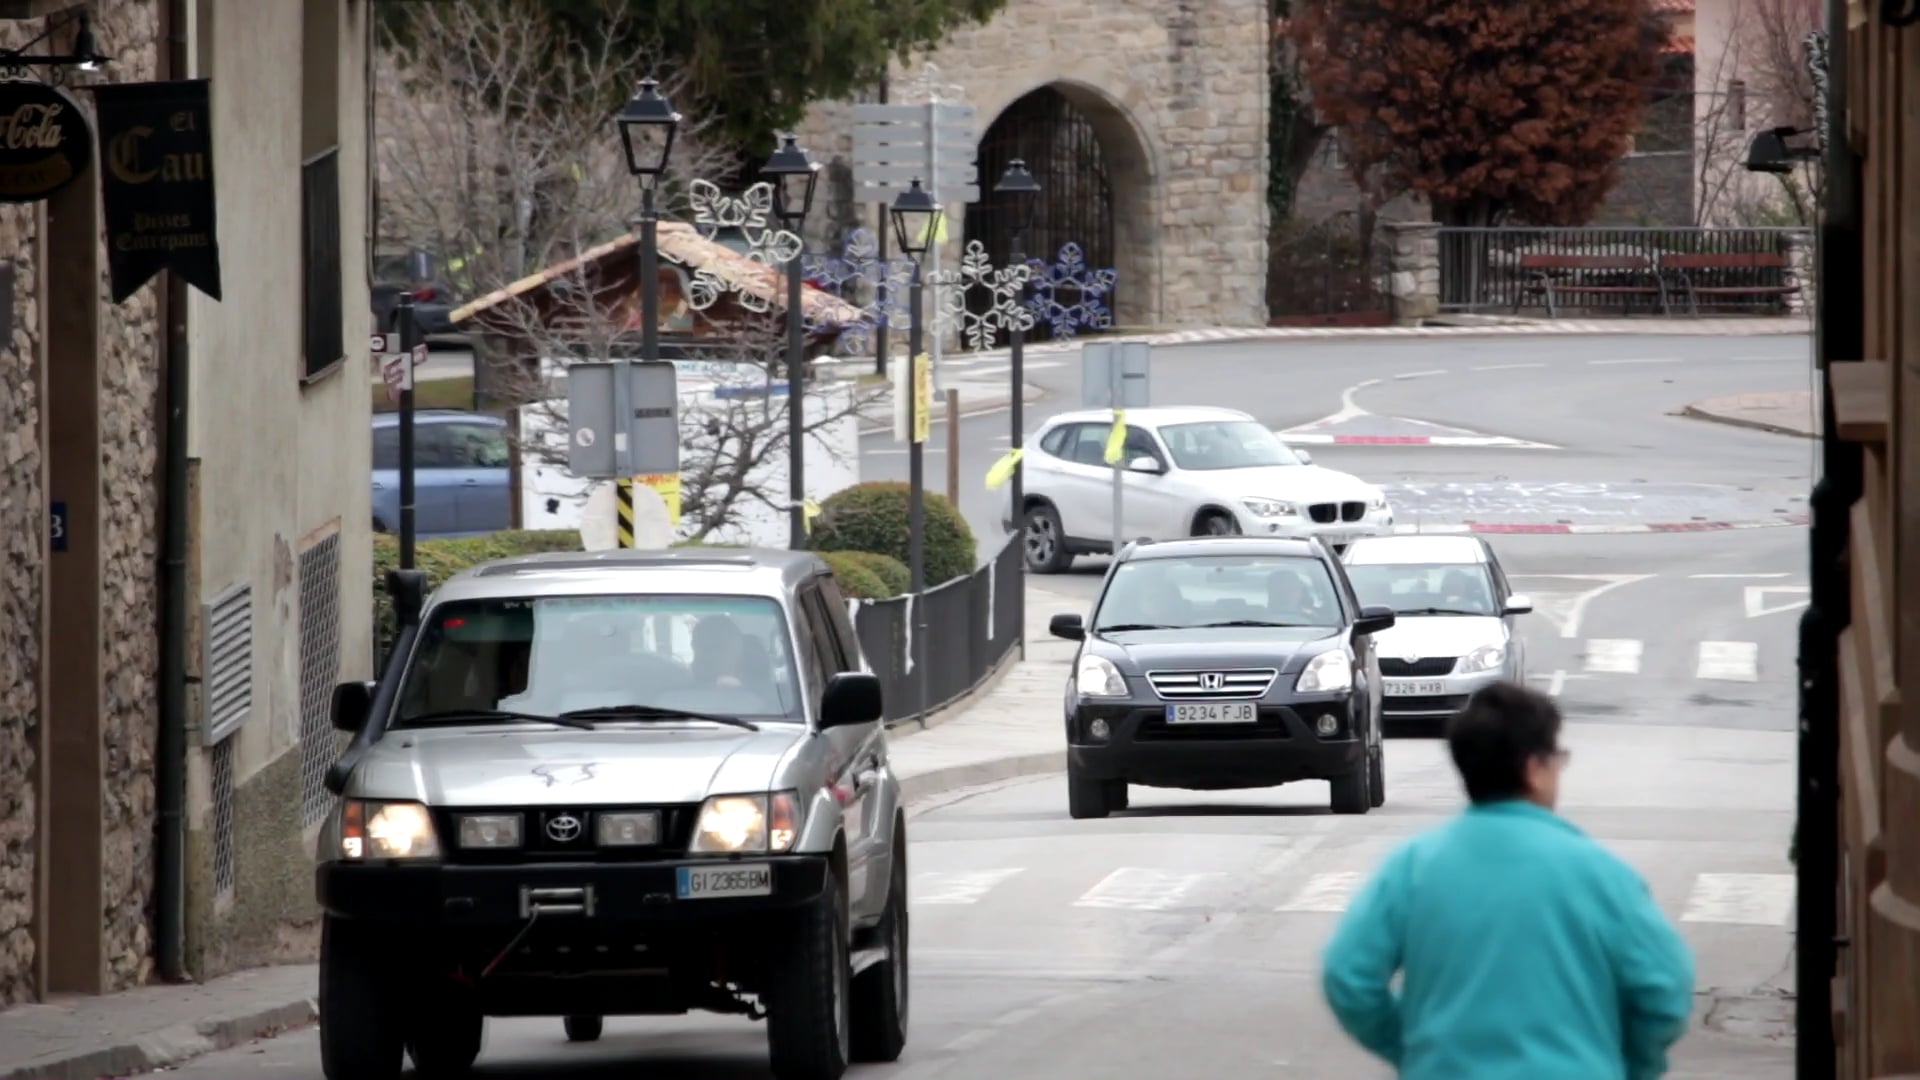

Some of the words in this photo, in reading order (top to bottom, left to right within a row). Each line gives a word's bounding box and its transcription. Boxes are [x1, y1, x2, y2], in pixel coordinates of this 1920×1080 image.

[169, 111, 196, 132] El
[108, 125, 205, 184] Cau
[1178, 705, 1217, 720] 9234
[1222, 704, 1252, 720] FJB
